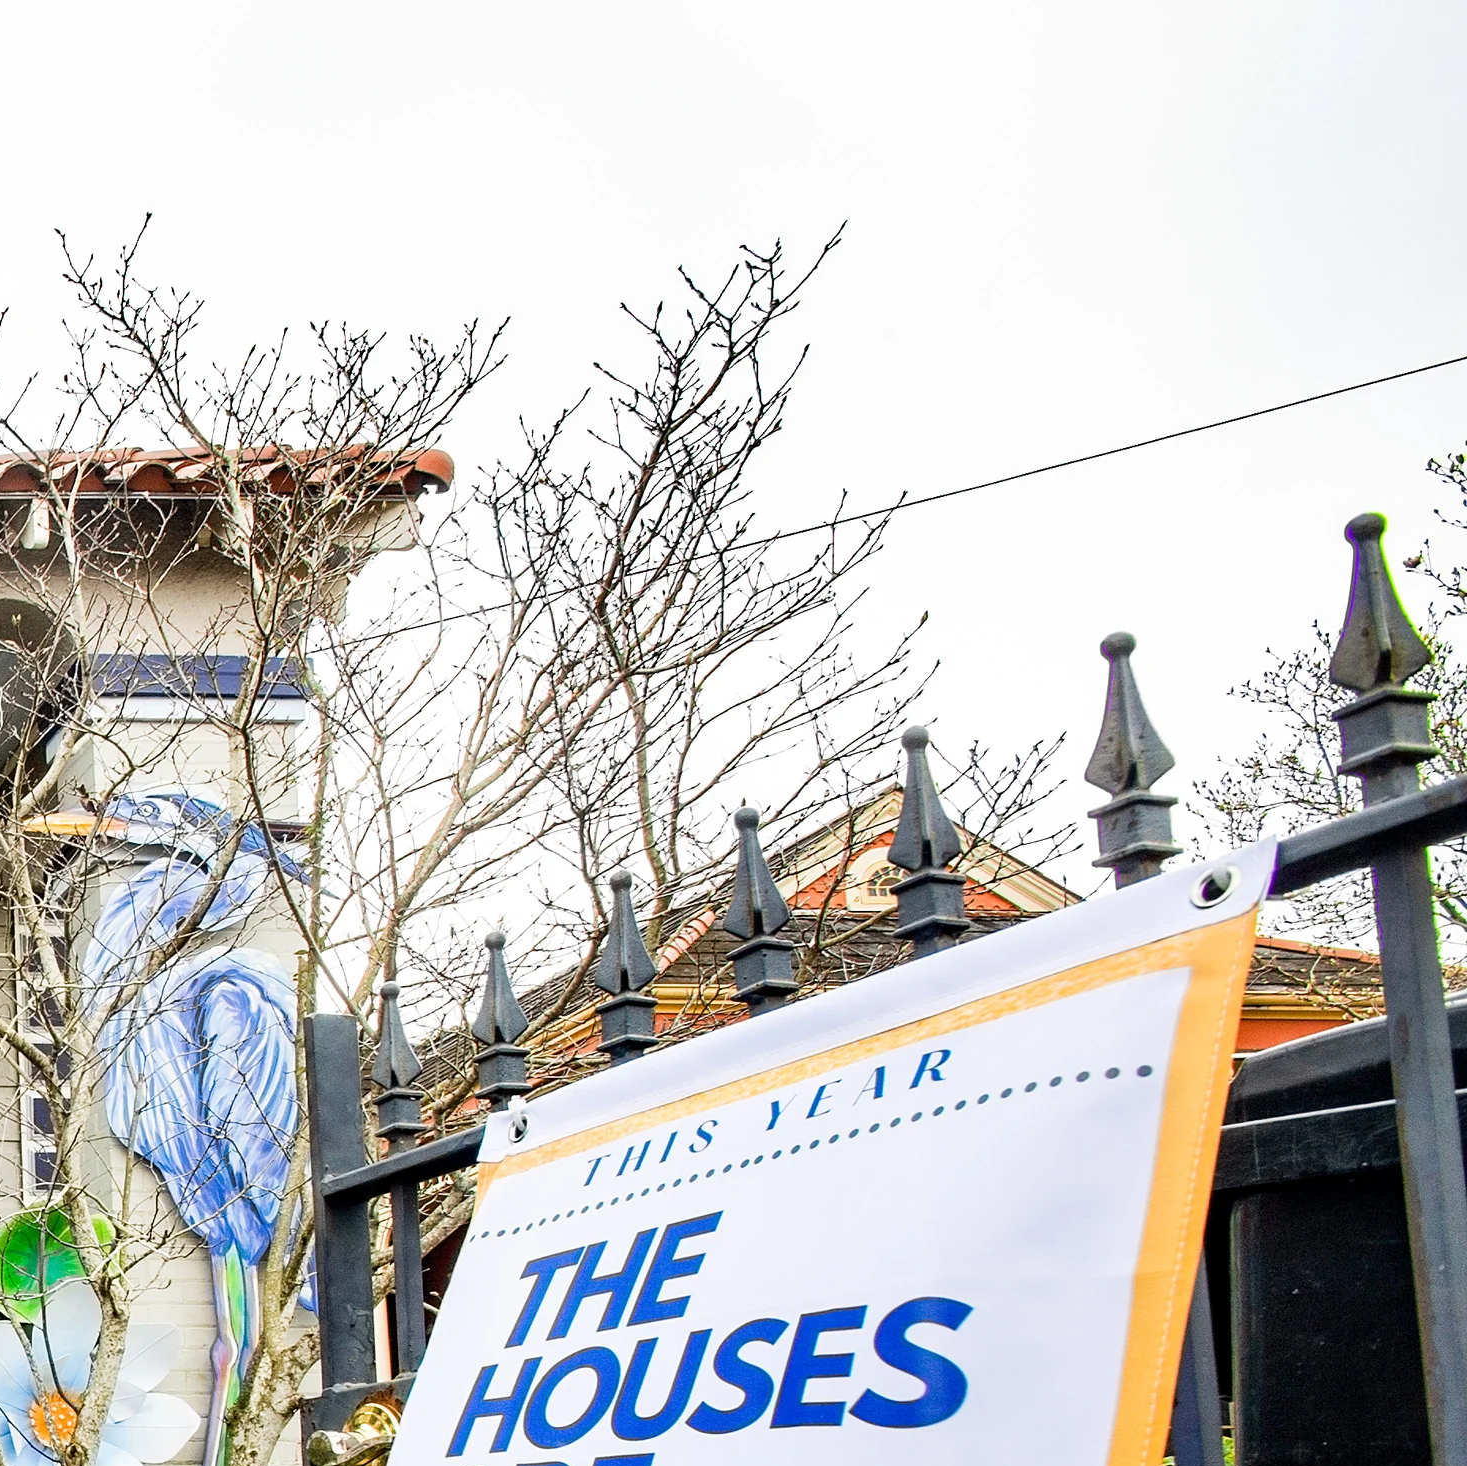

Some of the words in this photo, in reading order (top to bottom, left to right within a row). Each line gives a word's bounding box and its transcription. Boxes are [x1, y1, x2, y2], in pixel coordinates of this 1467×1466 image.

[583, 1119, 719, 1188] THIS
[765, 1047, 954, 1133] YEAR
[503, 1209, 724, 1349] THE
[444, 1295, 975, 1459] HOUSES
